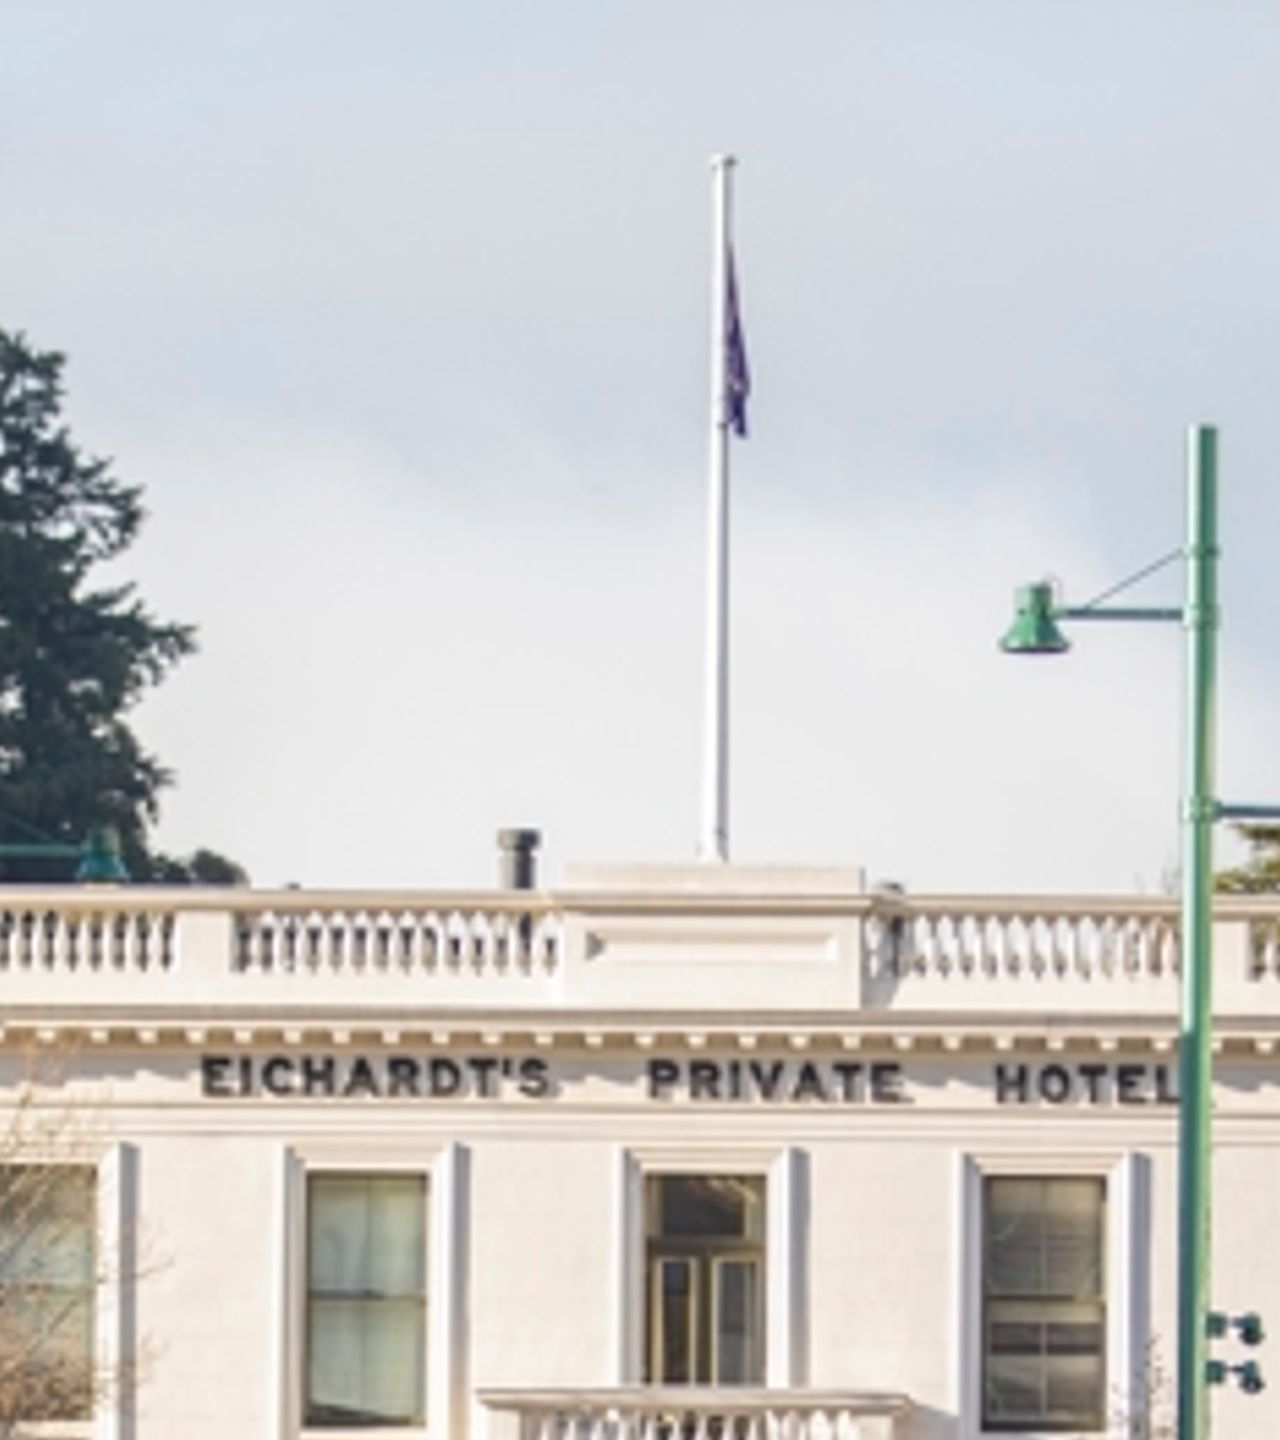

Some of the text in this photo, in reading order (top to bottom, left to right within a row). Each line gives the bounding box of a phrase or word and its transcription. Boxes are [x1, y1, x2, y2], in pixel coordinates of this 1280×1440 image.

[201, 1055, 1181, 1104] EICHARDT'S PRIVATE HOTEL
